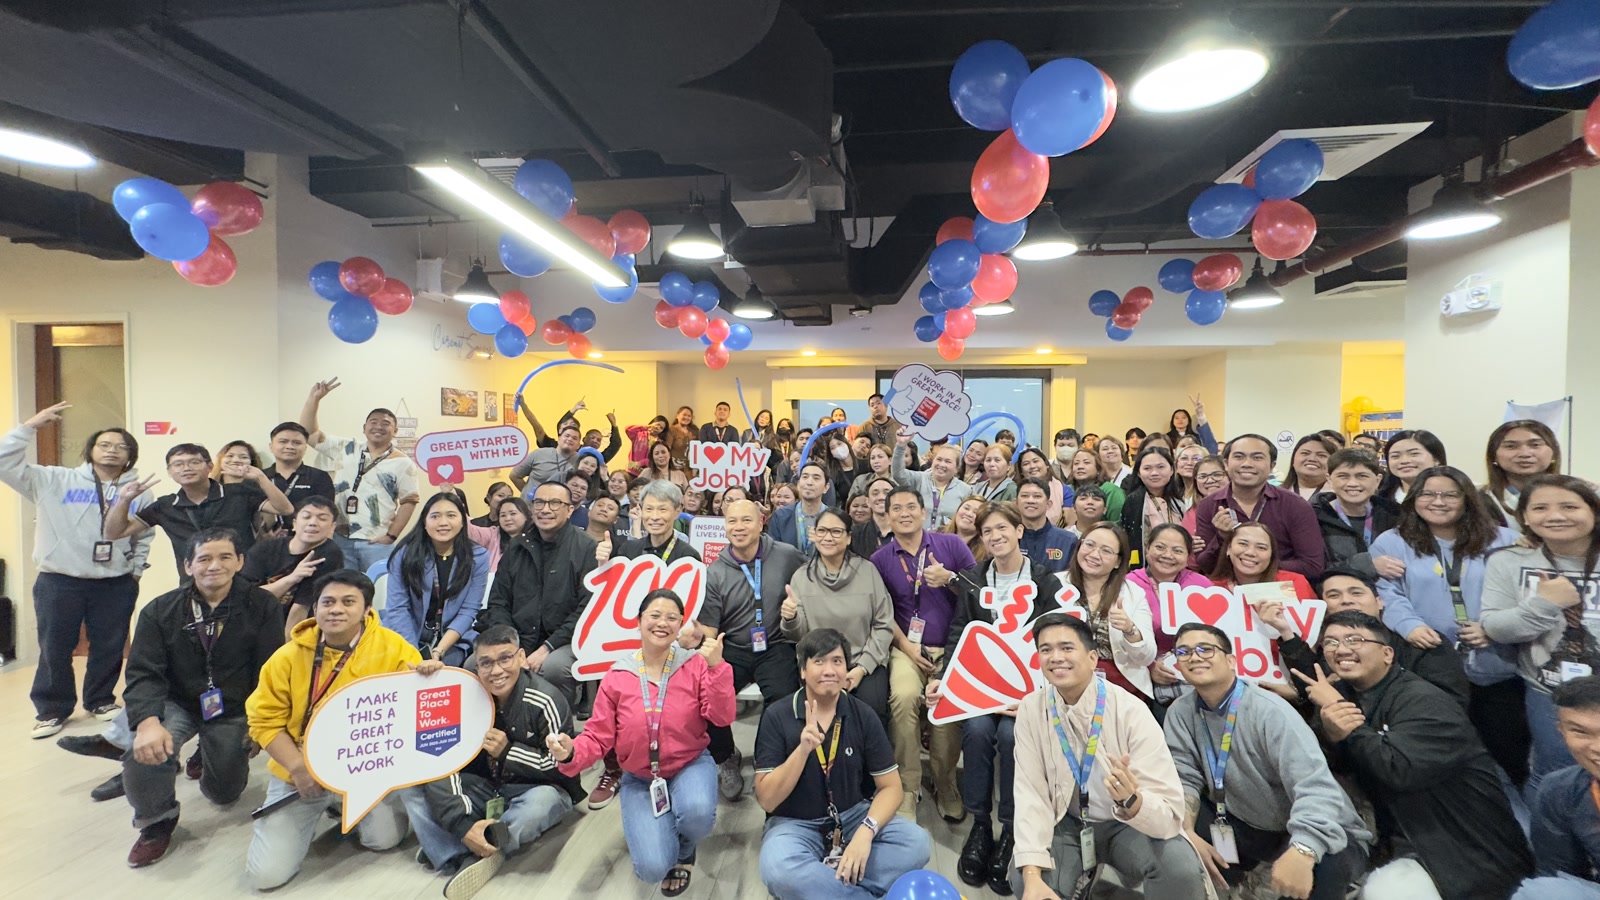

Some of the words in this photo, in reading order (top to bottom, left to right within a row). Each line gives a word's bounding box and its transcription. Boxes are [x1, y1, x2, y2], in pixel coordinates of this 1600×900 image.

[911, 377, 936, 395] GREAT
[935, 393, 961, 412] PLACE!
[923, 375, 946, 393] WORK
[946, 391, 955, 400] IN
[955, 397, 962, 405] A
[430, 440, 469, 452] GREAT
[471, 434, 518, 448] STARTS
[469, 448, 500, 460] WITH
[502, 446, 520, 457] ME
[693, 444, 698, 465] I
[731, 445, 766, 473] My
[693, 467, 747, 488] Job!
[1045, 547, 1064, 560] TD
[1167, 589, 1177, 628] I
[346, 697, 350, 710] I
[356, 691, 398, 709] MAKE
[419, 689, 451, 700] Great
[420, 699, 450, 709] Place
[348, 708, 383, 725] THIS
[387, 707, 396, 719] A
[419, 710, 431, 718] To
[350, 722, 393, 741] GREAT
[420, 727, 457, 741] Certified
[337, 741, 380, 760] PLACE
[384, 738, 404, 751] TO
[347, 755, 395, 774] WORK
